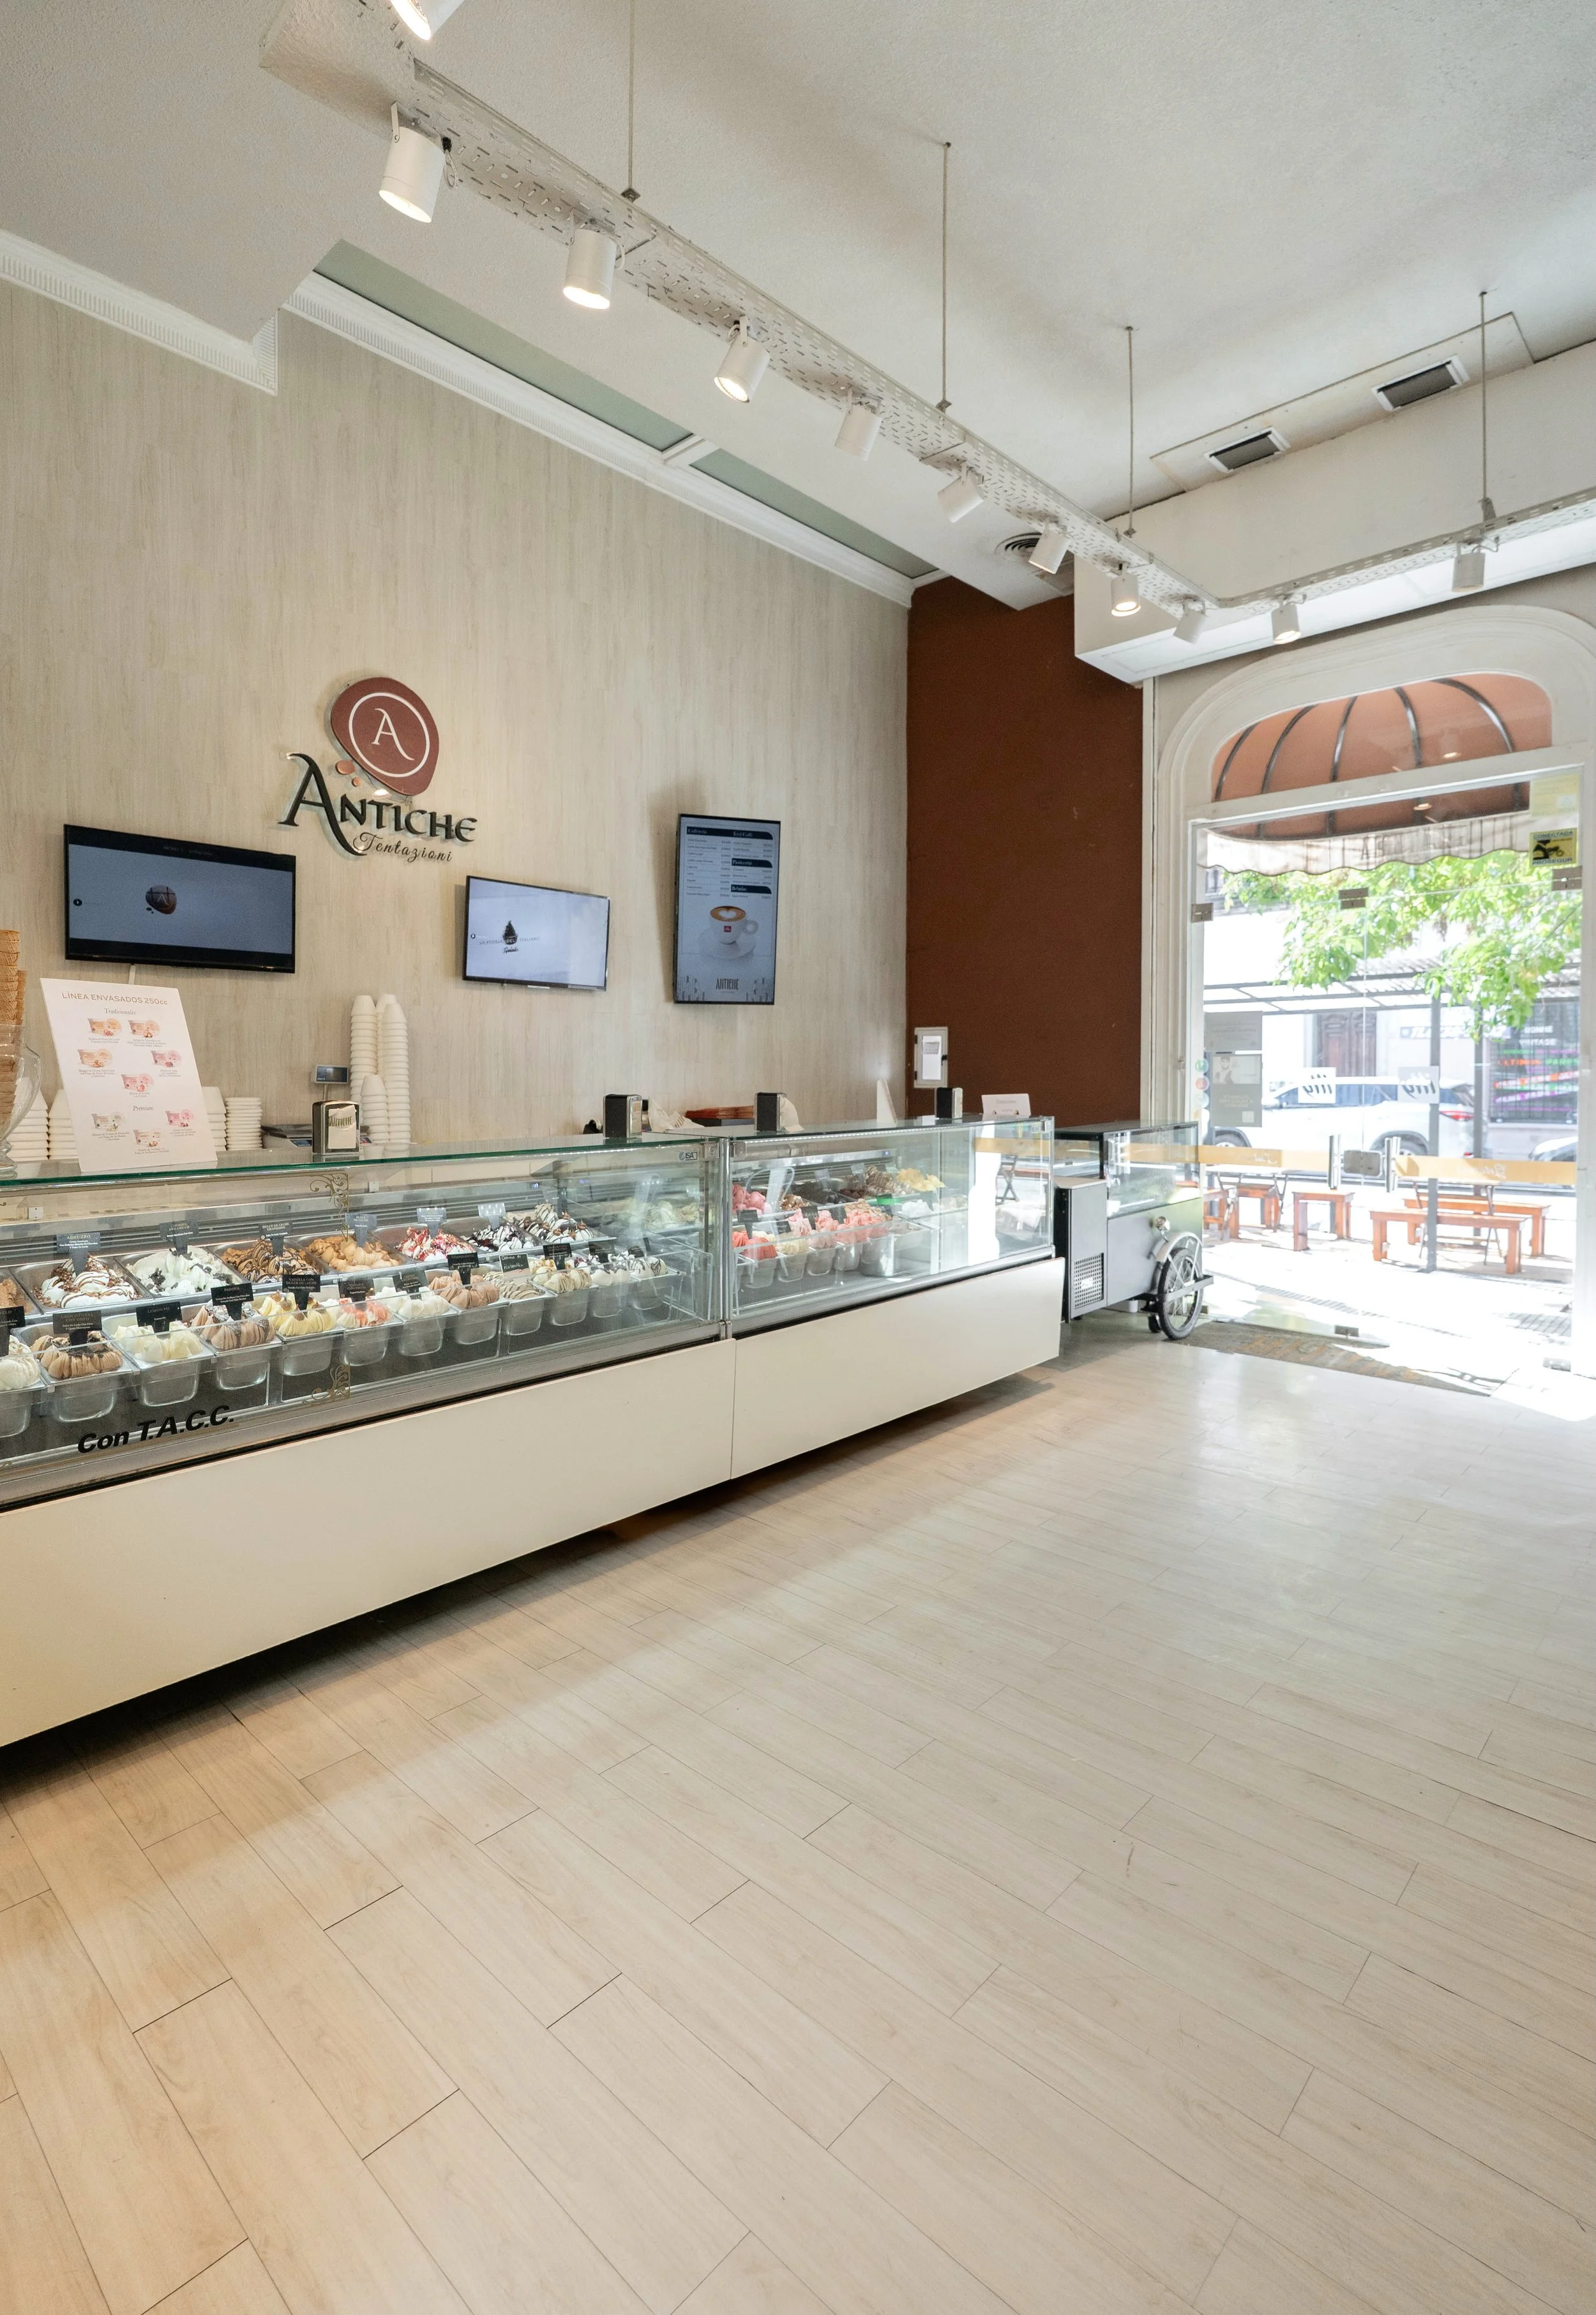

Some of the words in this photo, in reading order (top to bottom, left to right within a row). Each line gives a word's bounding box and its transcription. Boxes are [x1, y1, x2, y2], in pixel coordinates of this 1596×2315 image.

[370, 707, 415, 761] A
[277, 753, 478, 856] ANTICHE
[352, 831, 452, 863] Tentazioni
[1533, 831, 1574, 840] CONECTADA
[61, 992, 89, 1000] LÍNEA
[91, 993, 143, 1003] ENVASADOS
[77, 1430, 130, 1453] Con
[137, 1405, 234, 1442] T.A.C.C.
